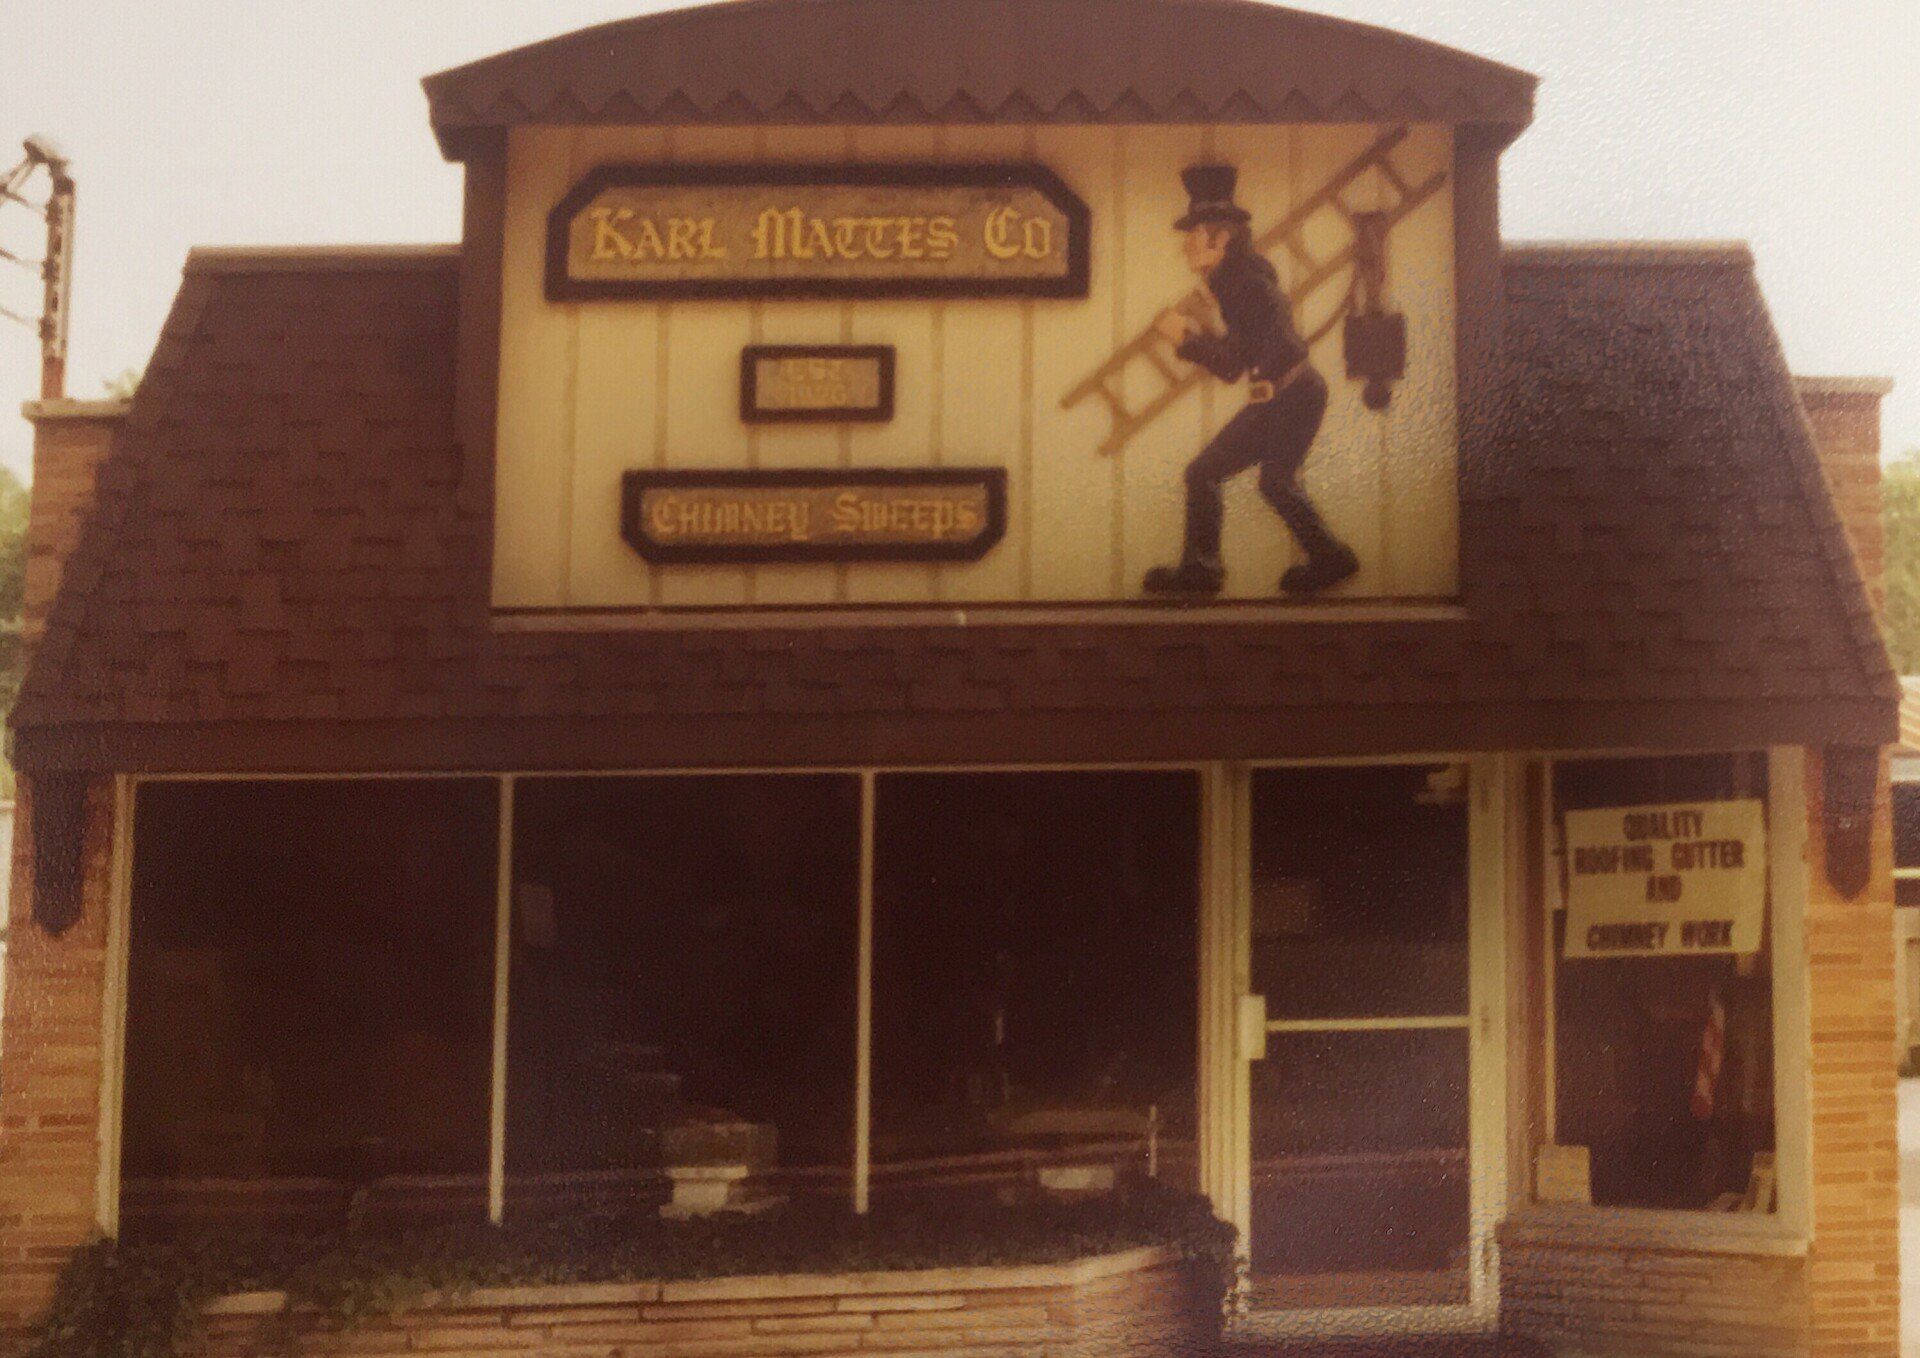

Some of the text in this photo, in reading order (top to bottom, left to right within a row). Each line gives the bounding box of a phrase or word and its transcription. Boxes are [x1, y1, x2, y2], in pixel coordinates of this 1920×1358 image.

[1622, 809, 1704, 841] QUALITY
[1574, 840, 1745, 874] ROOFING GUTTER
[1645, 875, 1682, 904] AND
[1586, 919, 1735, 951] CHIMNEY WORK
